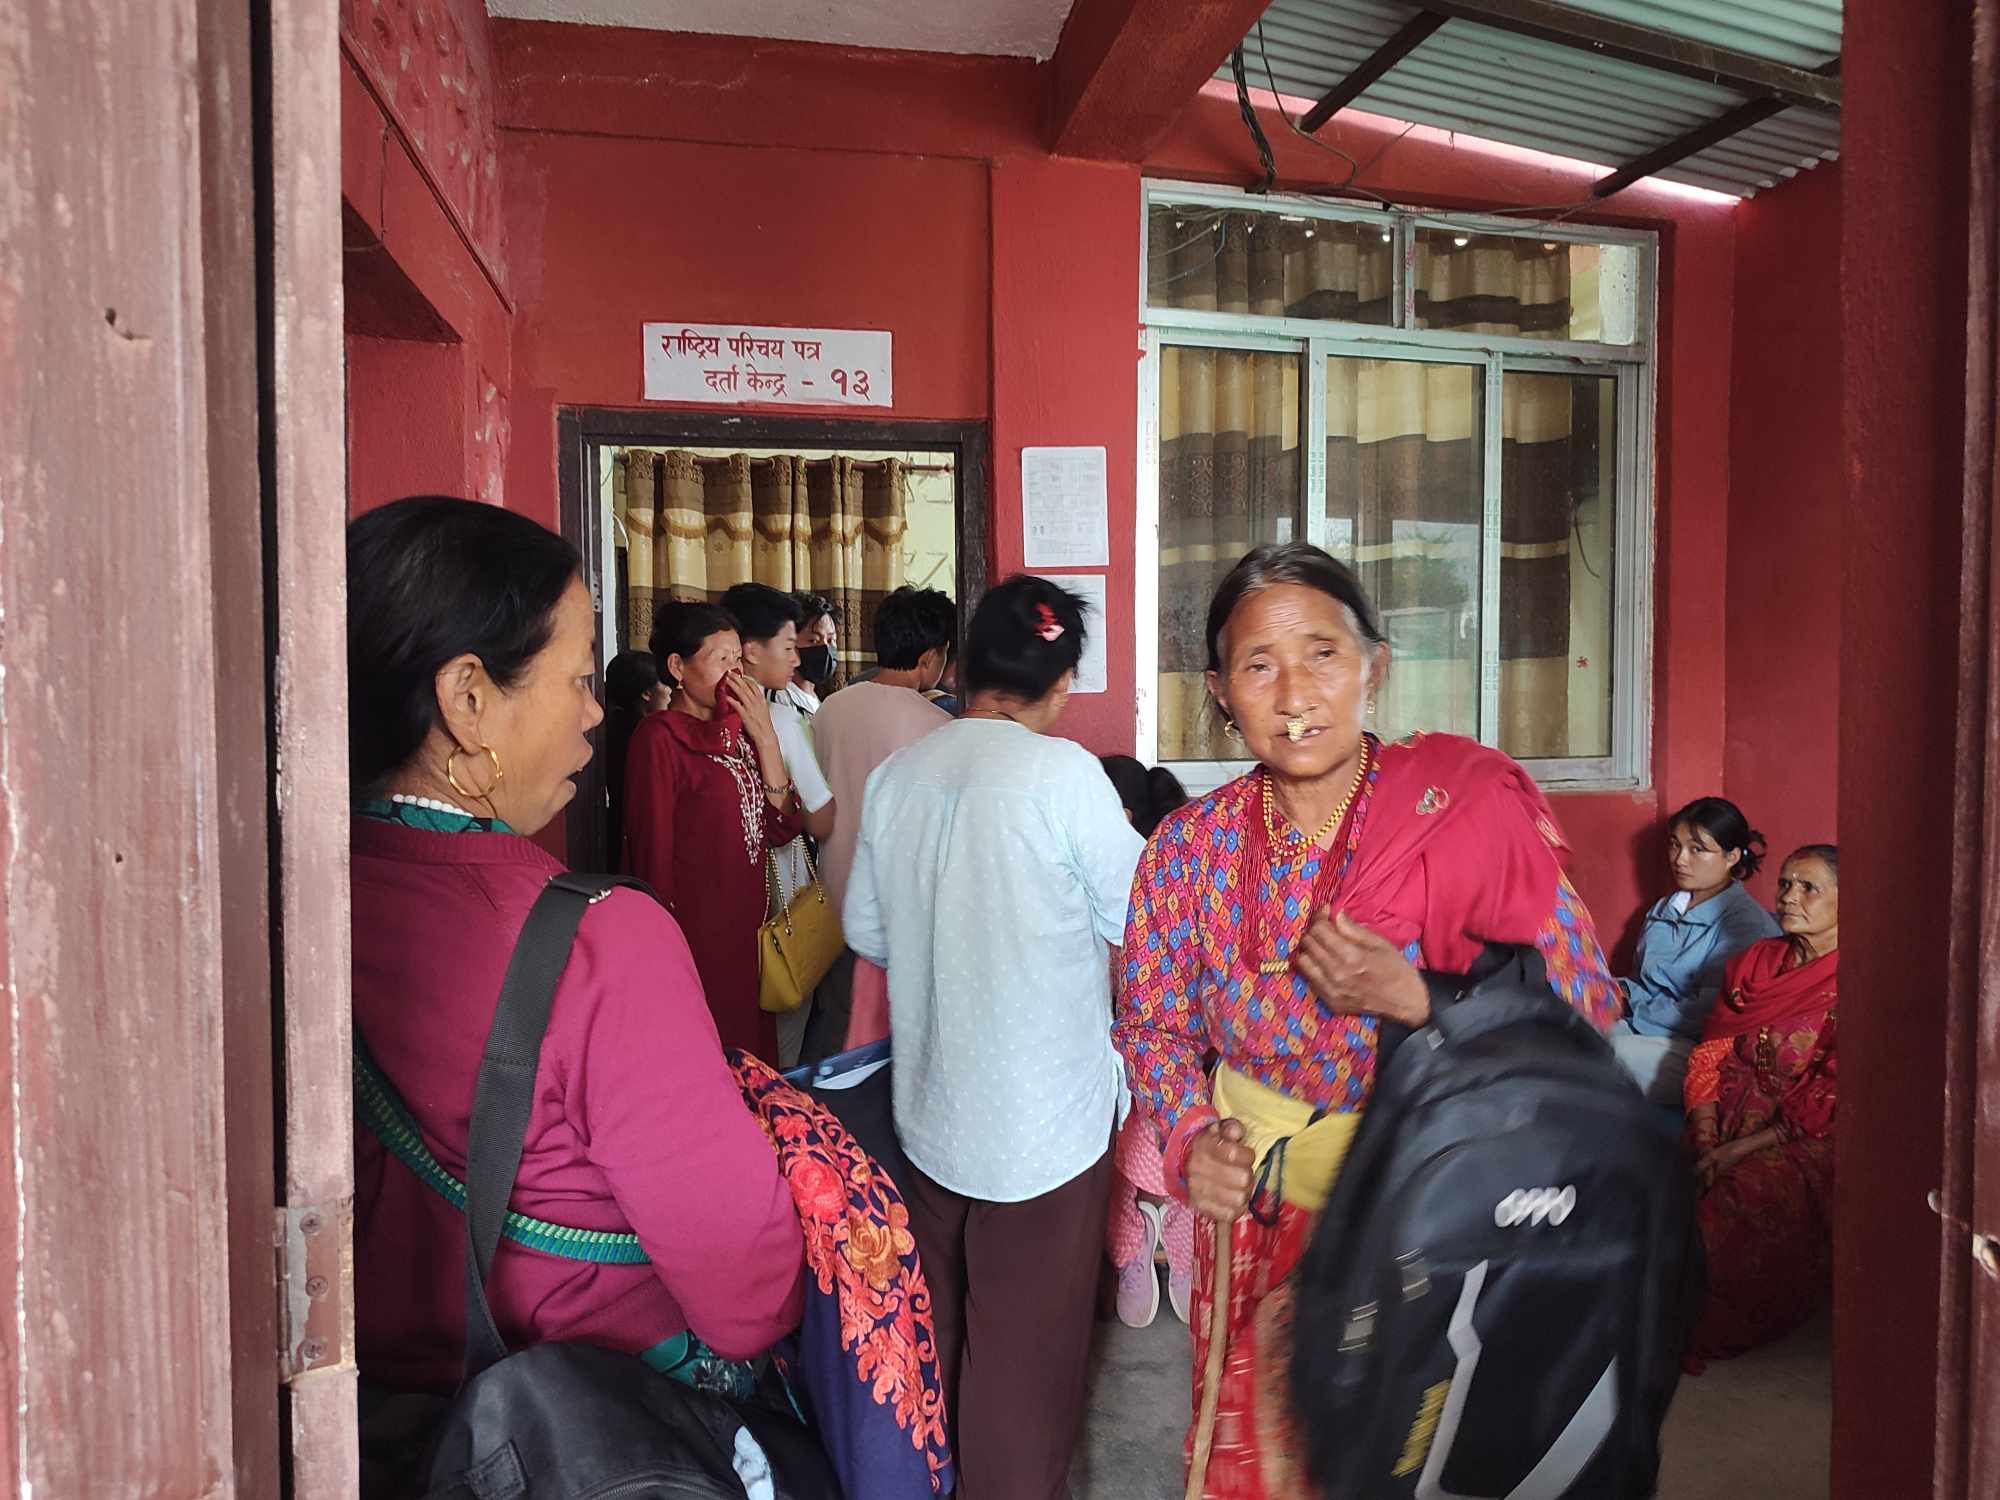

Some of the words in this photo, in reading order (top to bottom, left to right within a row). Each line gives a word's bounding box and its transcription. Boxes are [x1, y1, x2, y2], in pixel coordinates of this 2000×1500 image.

[661, 329, 720, 359] राष्ट्रिय
[727, 332, 784, 359] परिचय
[791, 341, 821, 360] पत्र
[703, 365, 739, 392] दर्ता
[746, 364, 787, 396] केन्द्र
[831, 368, 871, 401] १३
